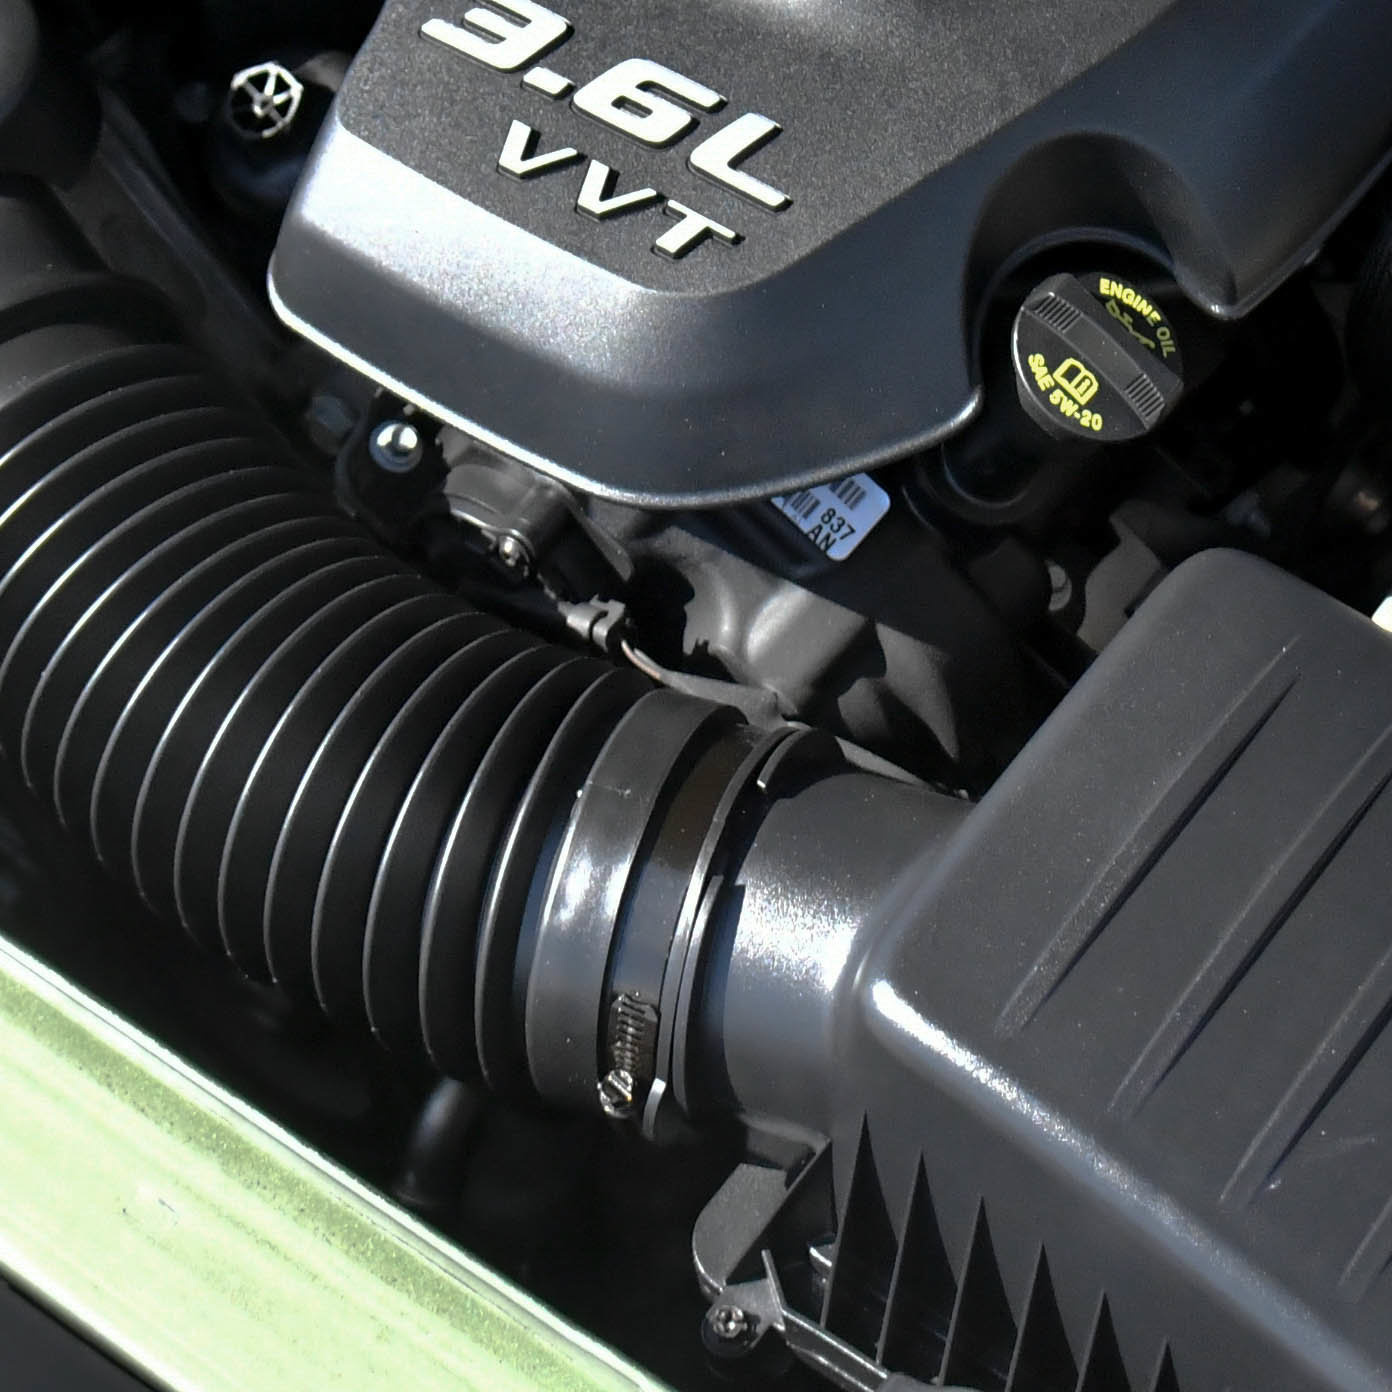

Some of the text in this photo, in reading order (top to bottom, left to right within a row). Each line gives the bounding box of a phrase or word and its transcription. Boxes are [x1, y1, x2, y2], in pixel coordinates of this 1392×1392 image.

[498, 119, 738, 256] VVT
[1099, 277, 1176, 358] ENGINE OIL
[1028, 353, 1102, 431] SAE 5W-20
[808, 525, 837, 553] AN
[821, 508, 856, 542] 837
